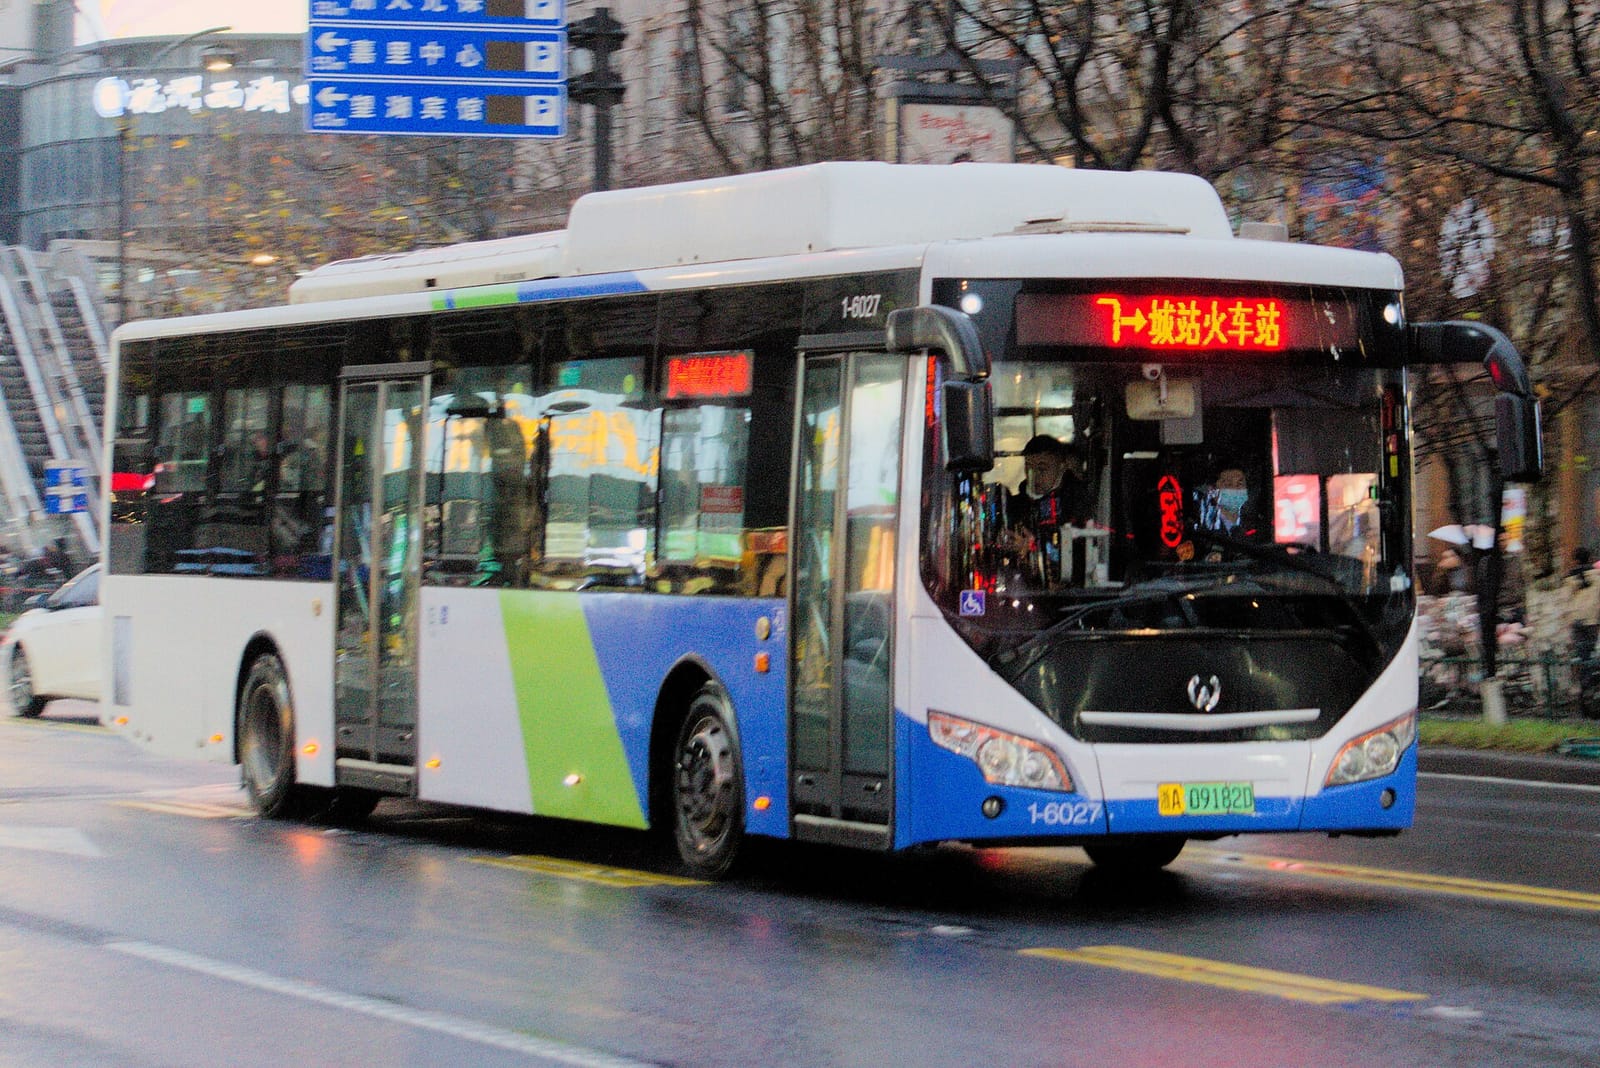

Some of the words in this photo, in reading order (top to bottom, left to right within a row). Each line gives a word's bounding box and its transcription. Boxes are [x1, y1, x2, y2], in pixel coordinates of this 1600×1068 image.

[840, 294, 882, 319] 1-6027
[1189, 786, 1253, 810] 09182D
[1027, 801, 1102, 825] 1-6027
